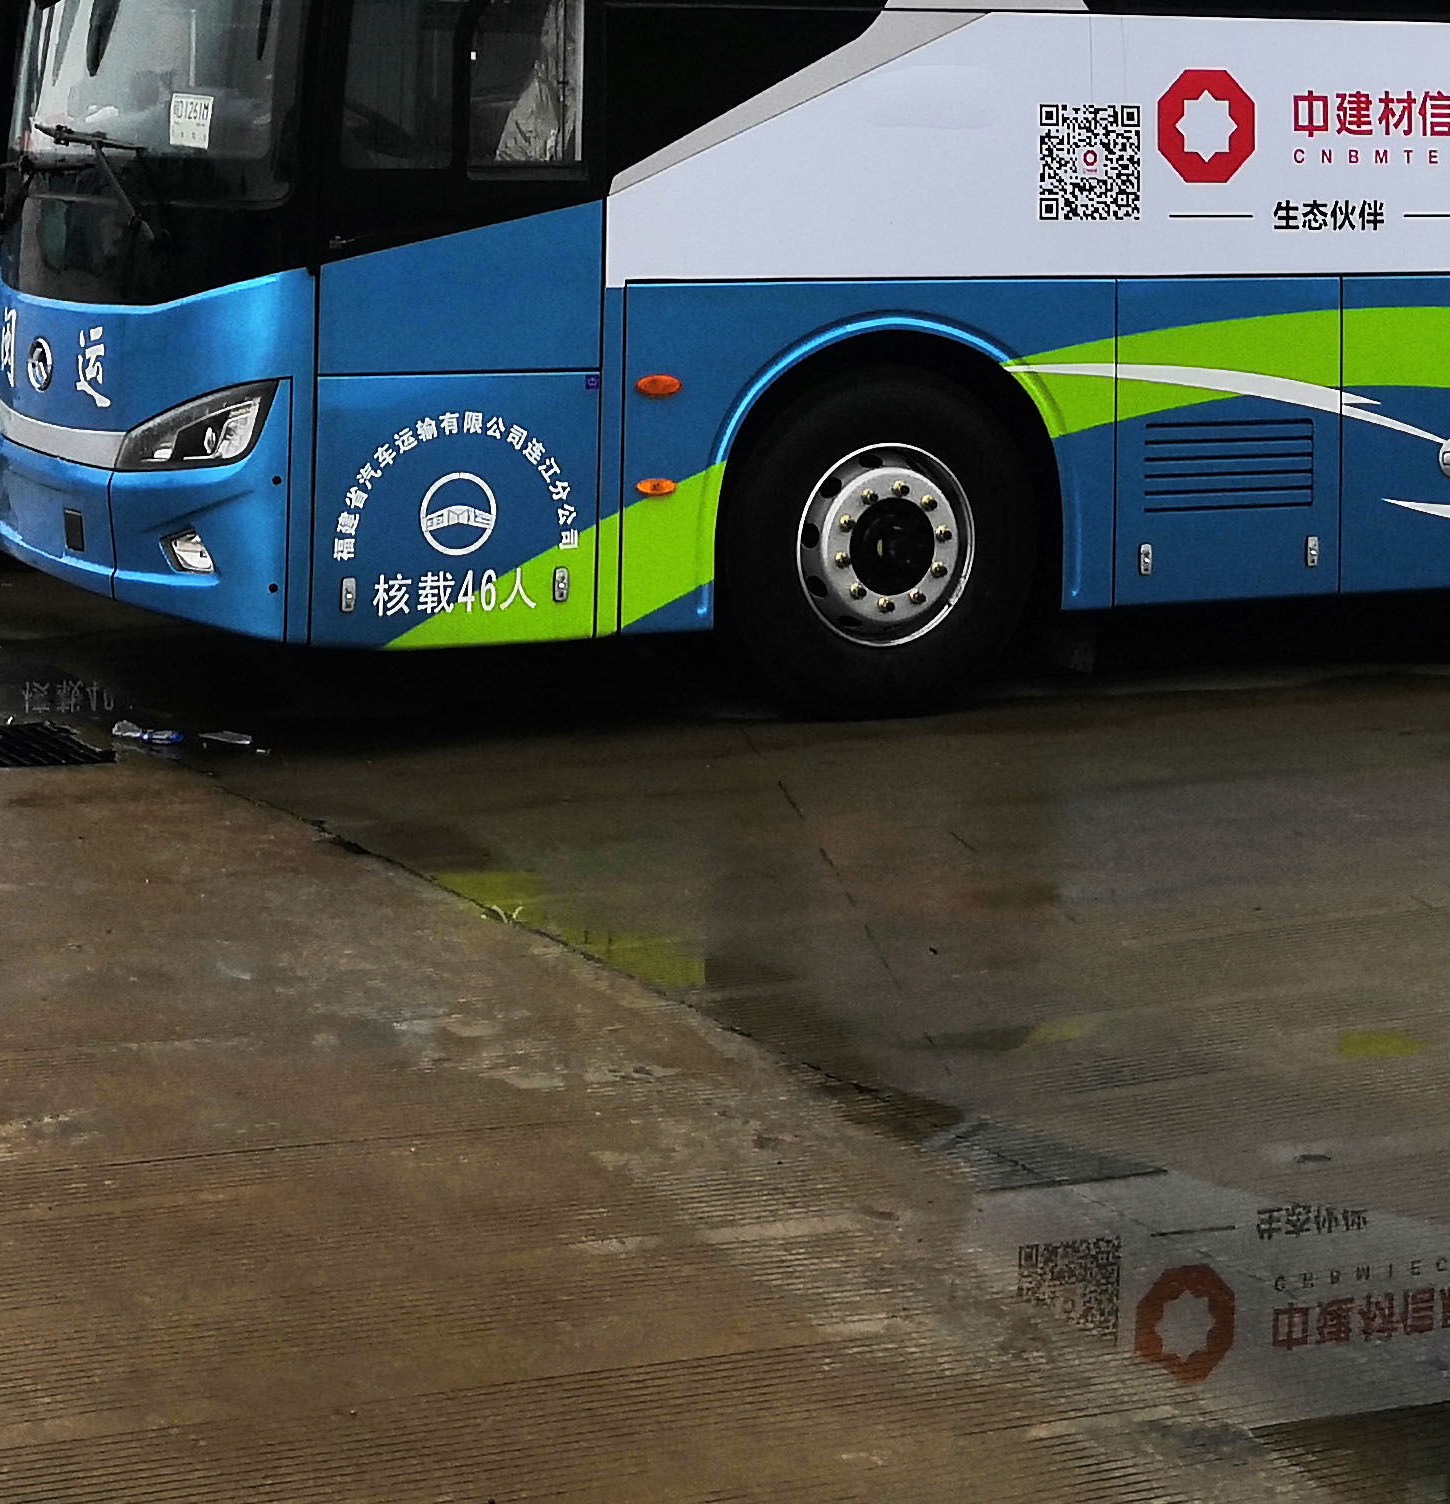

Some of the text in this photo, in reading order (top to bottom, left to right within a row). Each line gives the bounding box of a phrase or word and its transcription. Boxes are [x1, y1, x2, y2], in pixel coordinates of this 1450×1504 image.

[1273, 199, 1386, 232] 生态伙伴
[75, 325, 112, 408] 运
[332, 410, 579, 562] 福建省汽车运输有限公司连江分公司
[372, 566, 537, 617] 核载46人
